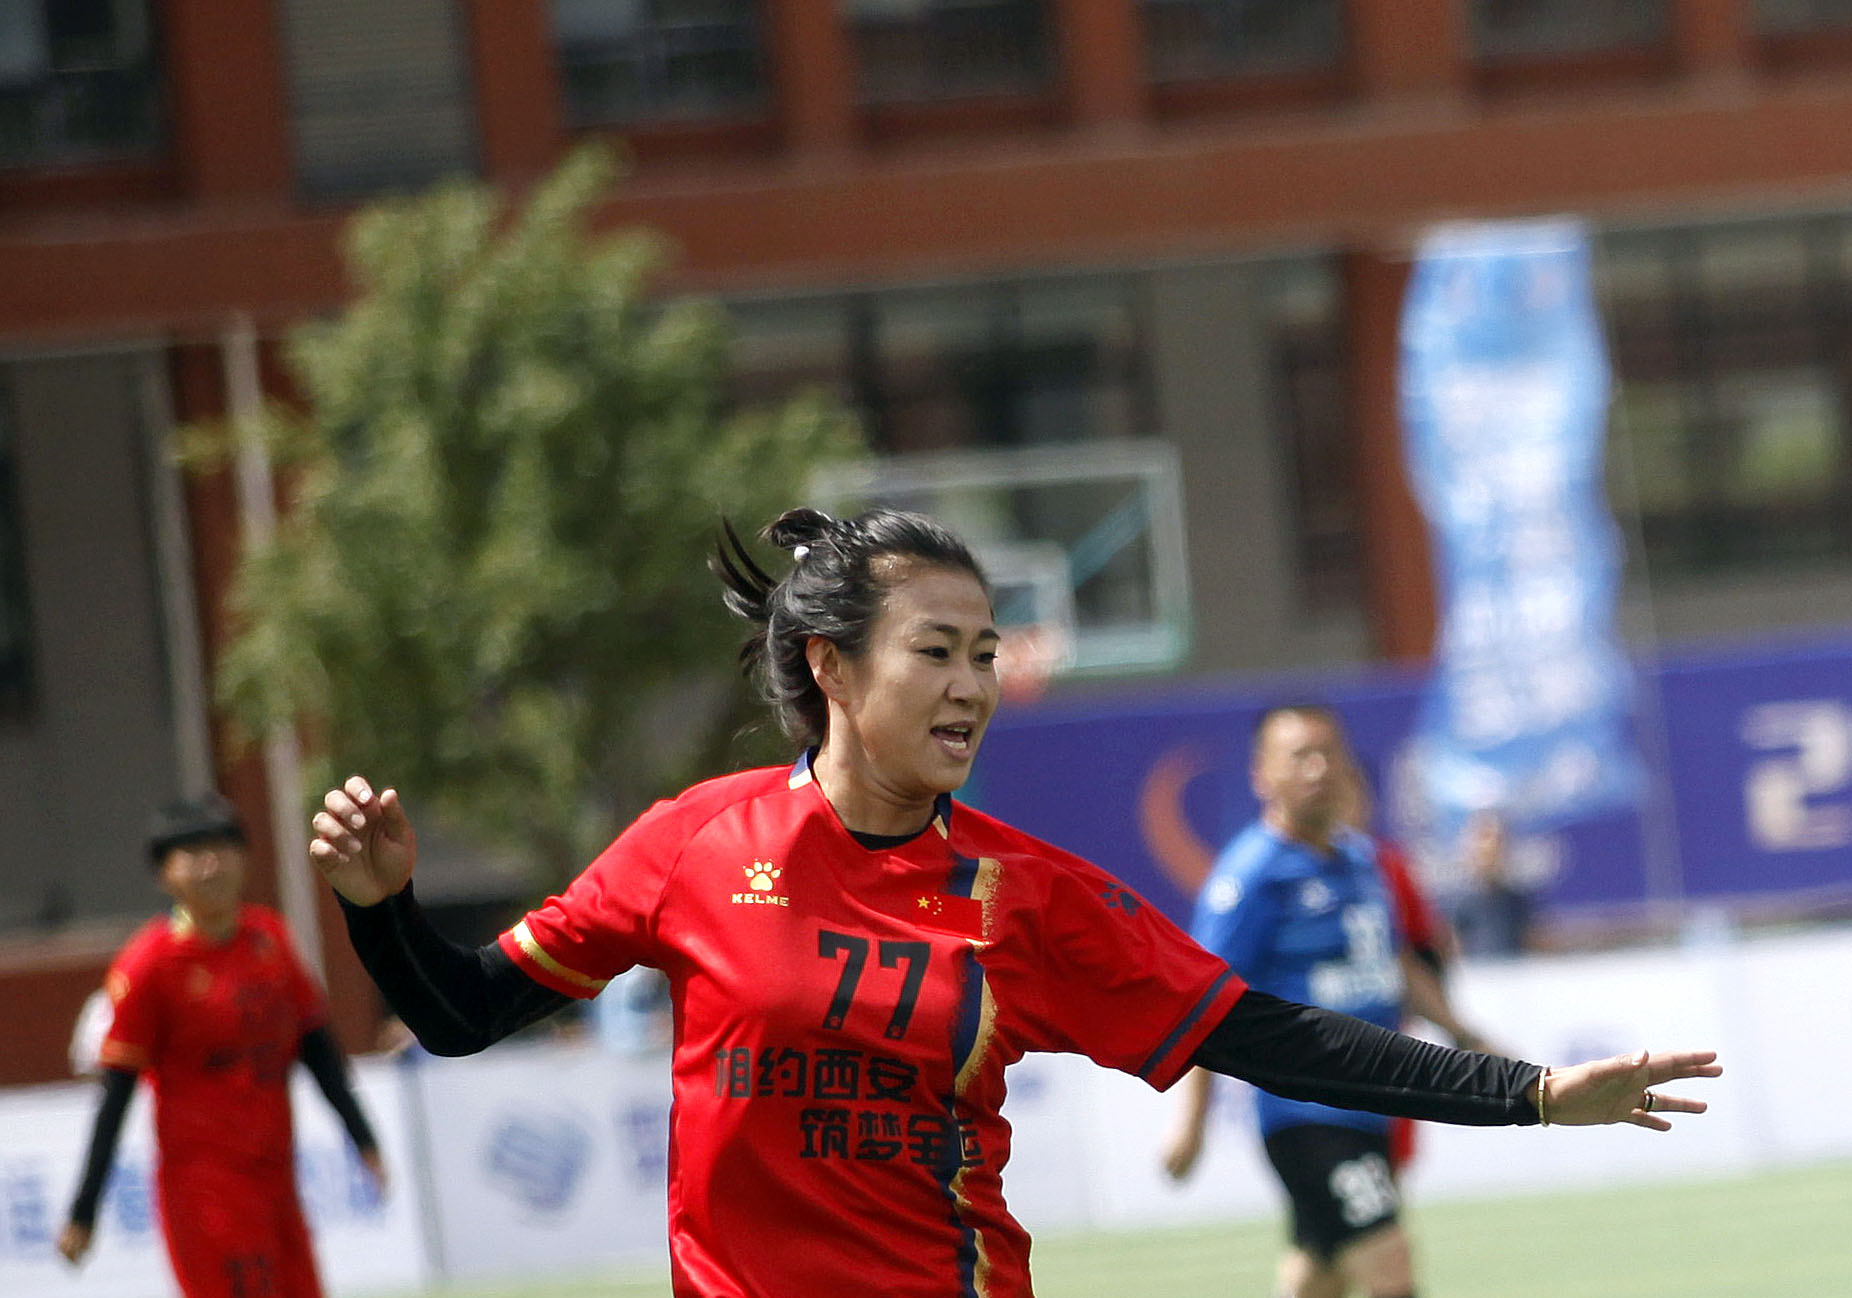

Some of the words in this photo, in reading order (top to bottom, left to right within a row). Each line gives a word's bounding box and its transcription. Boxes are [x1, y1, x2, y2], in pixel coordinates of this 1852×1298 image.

[732, 893, 789, 907] KELME
[817, 930, 930, 1040] 77
[713, 1047, 919, 1102] 相约西安
